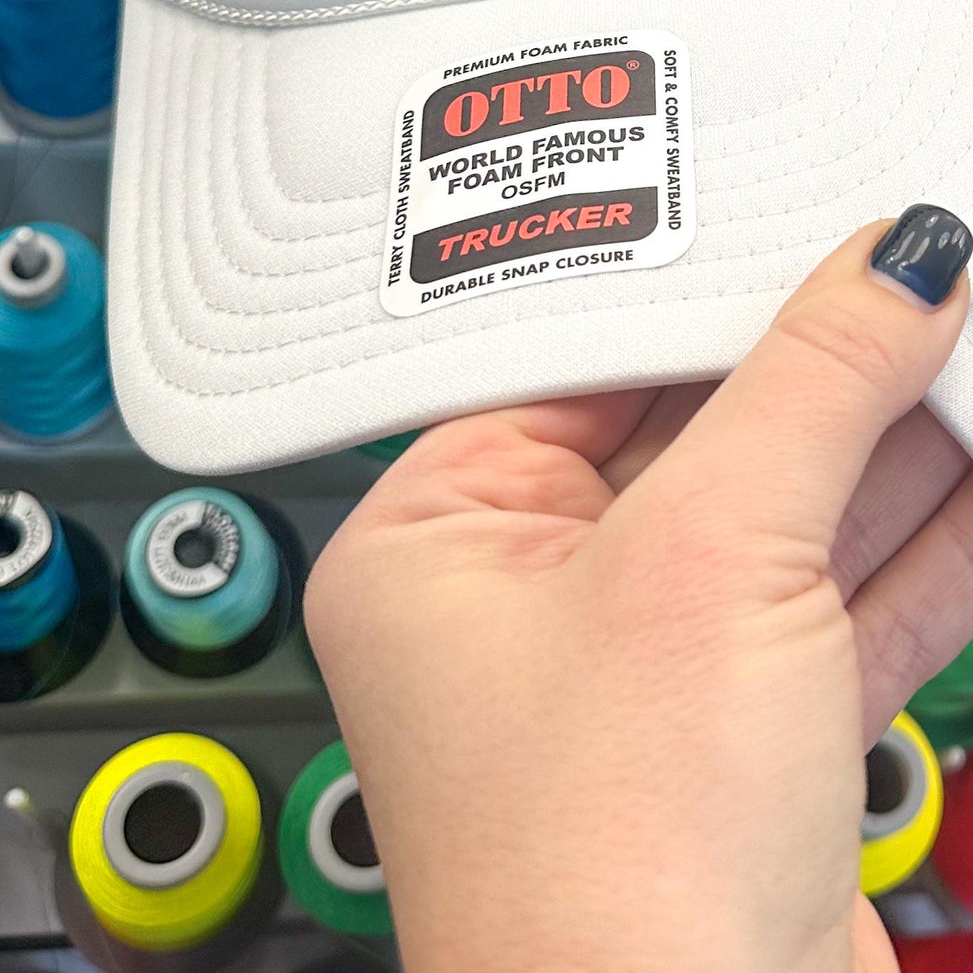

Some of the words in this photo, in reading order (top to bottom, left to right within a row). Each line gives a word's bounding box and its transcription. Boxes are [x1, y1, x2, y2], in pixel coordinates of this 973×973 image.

[443, 53, 515, 79] PREMIUM
[520, 43, 568, 60] FOAM
[573, 36, 628, 50] FABRIC
[664, 50, 677, 78] SOFT
[664, 83, 677, 93] &
[665, 97, 679, 144] COMFY
[398, 110, 415, 193] SWEATBAND
[428, 146, 523, 181] WORLD
[532, 127, 645, 155] FAMOUS
[448, 163, 522, 195] FOAM
[532, 146, 624, 173] FRONT
[502, 172, 566, 200] OSFM
[666, 148, 681, 230] SWEATBAND
[393, 196, 409, 240] CLOTH
[438, 203, 633, 261] TRUCKER
[388, 244, 404, 287] TERRY
[421, 273, 495, 304] DURABLE
[501, 261, 550, 281] SNAP
[555, 250, 634, 270] CLOSURE
